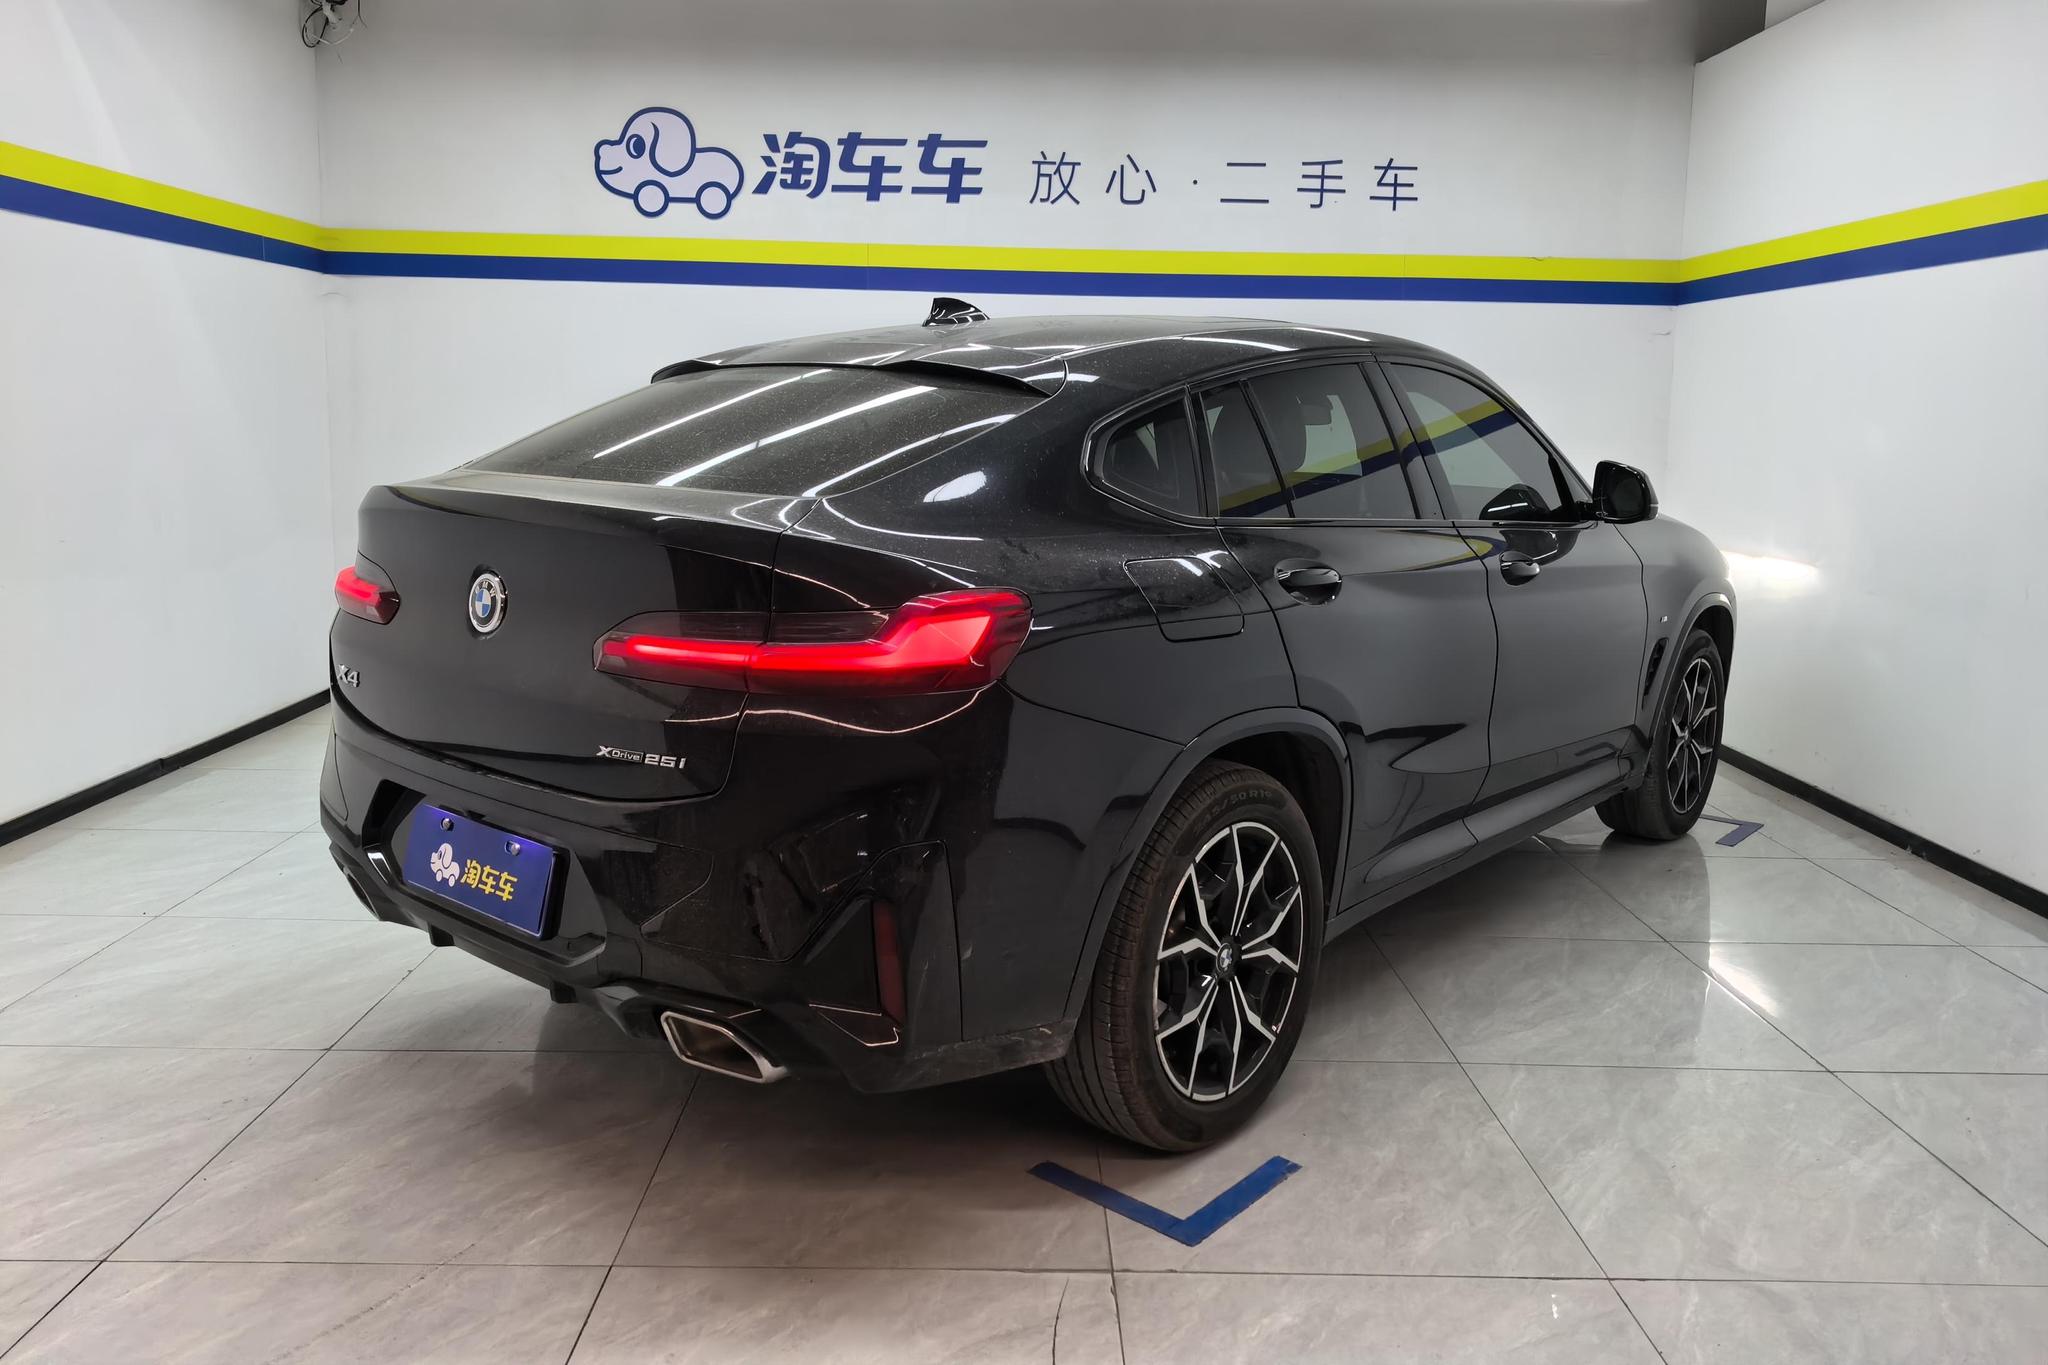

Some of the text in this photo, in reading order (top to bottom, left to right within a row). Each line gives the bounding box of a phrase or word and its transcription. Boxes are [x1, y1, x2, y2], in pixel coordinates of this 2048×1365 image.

[752, 131, 988, 204] 淘车车
[337, 664, 360, 688] X4
[460, 859, 518, 901] 淘车车
